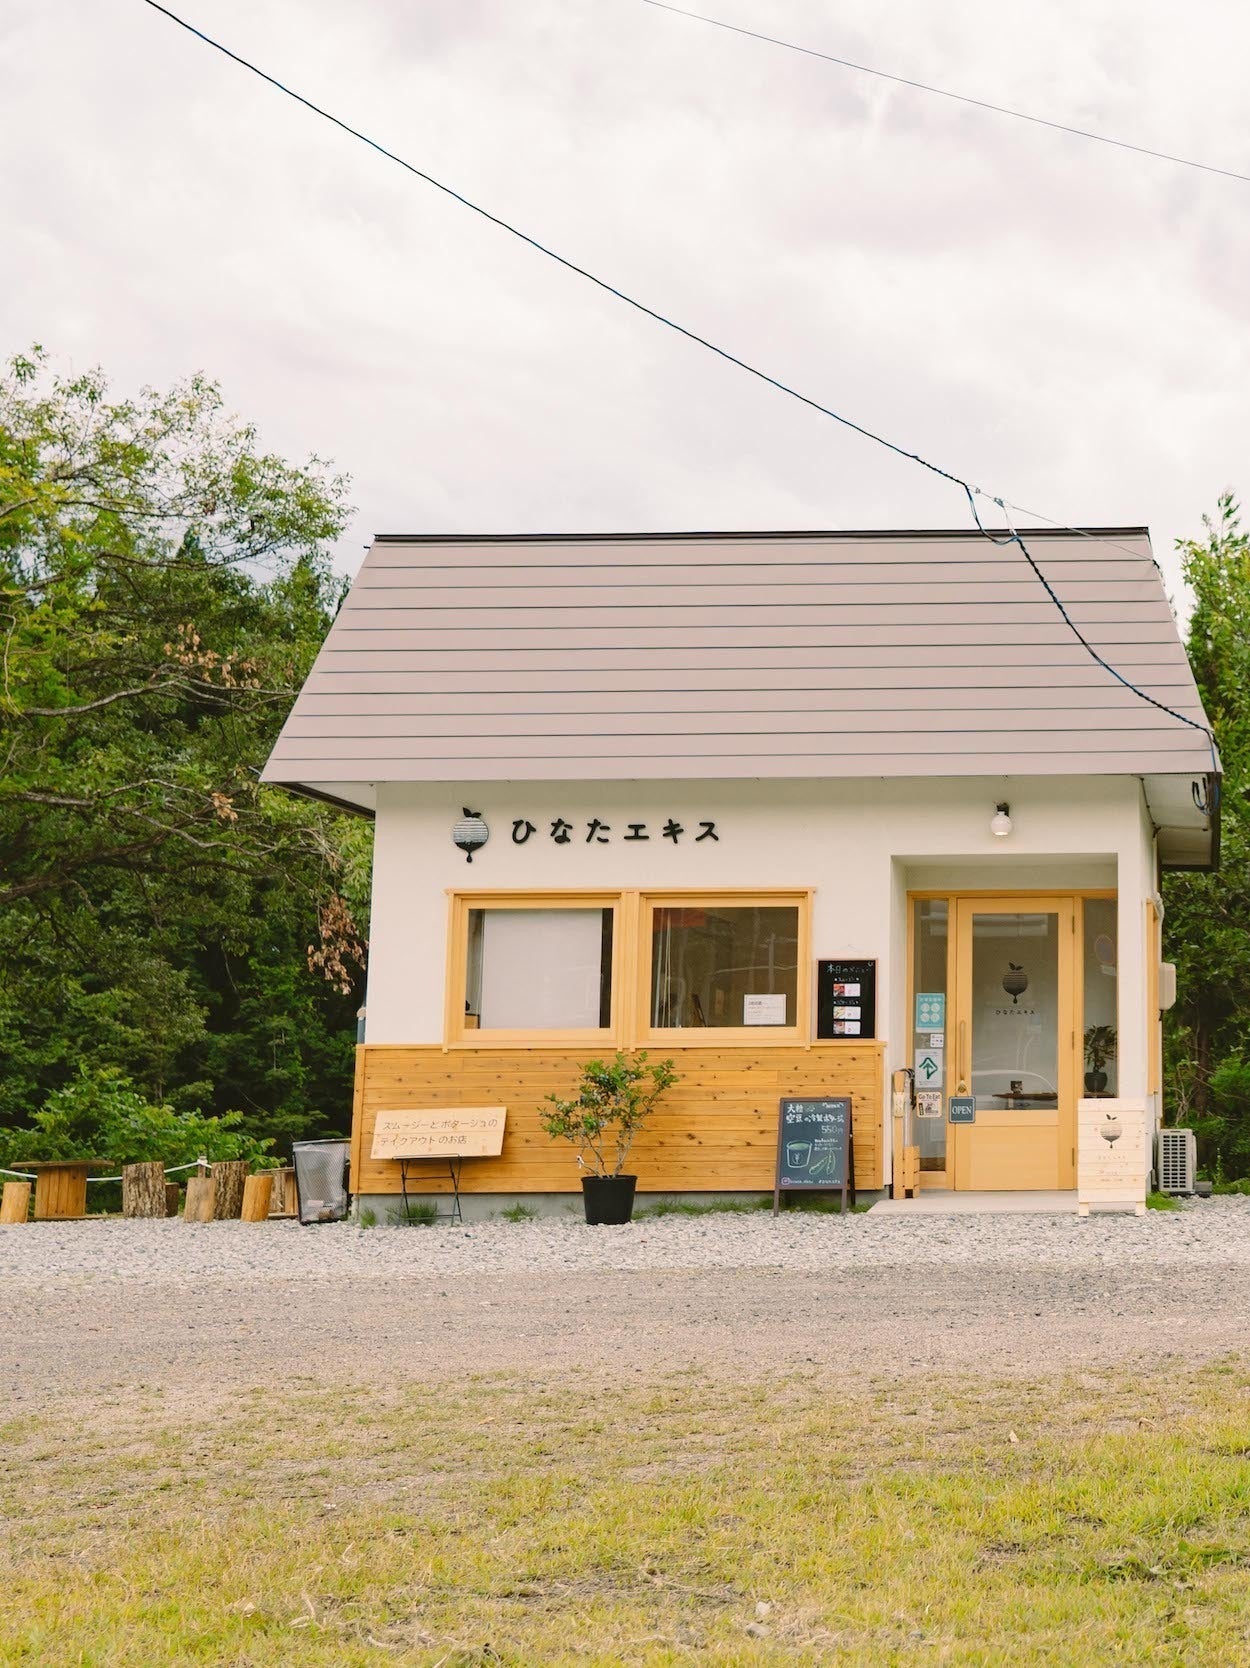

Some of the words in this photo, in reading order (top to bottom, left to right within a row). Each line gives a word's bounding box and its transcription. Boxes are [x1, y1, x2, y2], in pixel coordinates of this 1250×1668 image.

[511, 817, 720, 845] ひなたエキス
[951, 1105, 973, 1115] OPEN
[382, 1118, 498, 1131] スムージーとポタージュの
